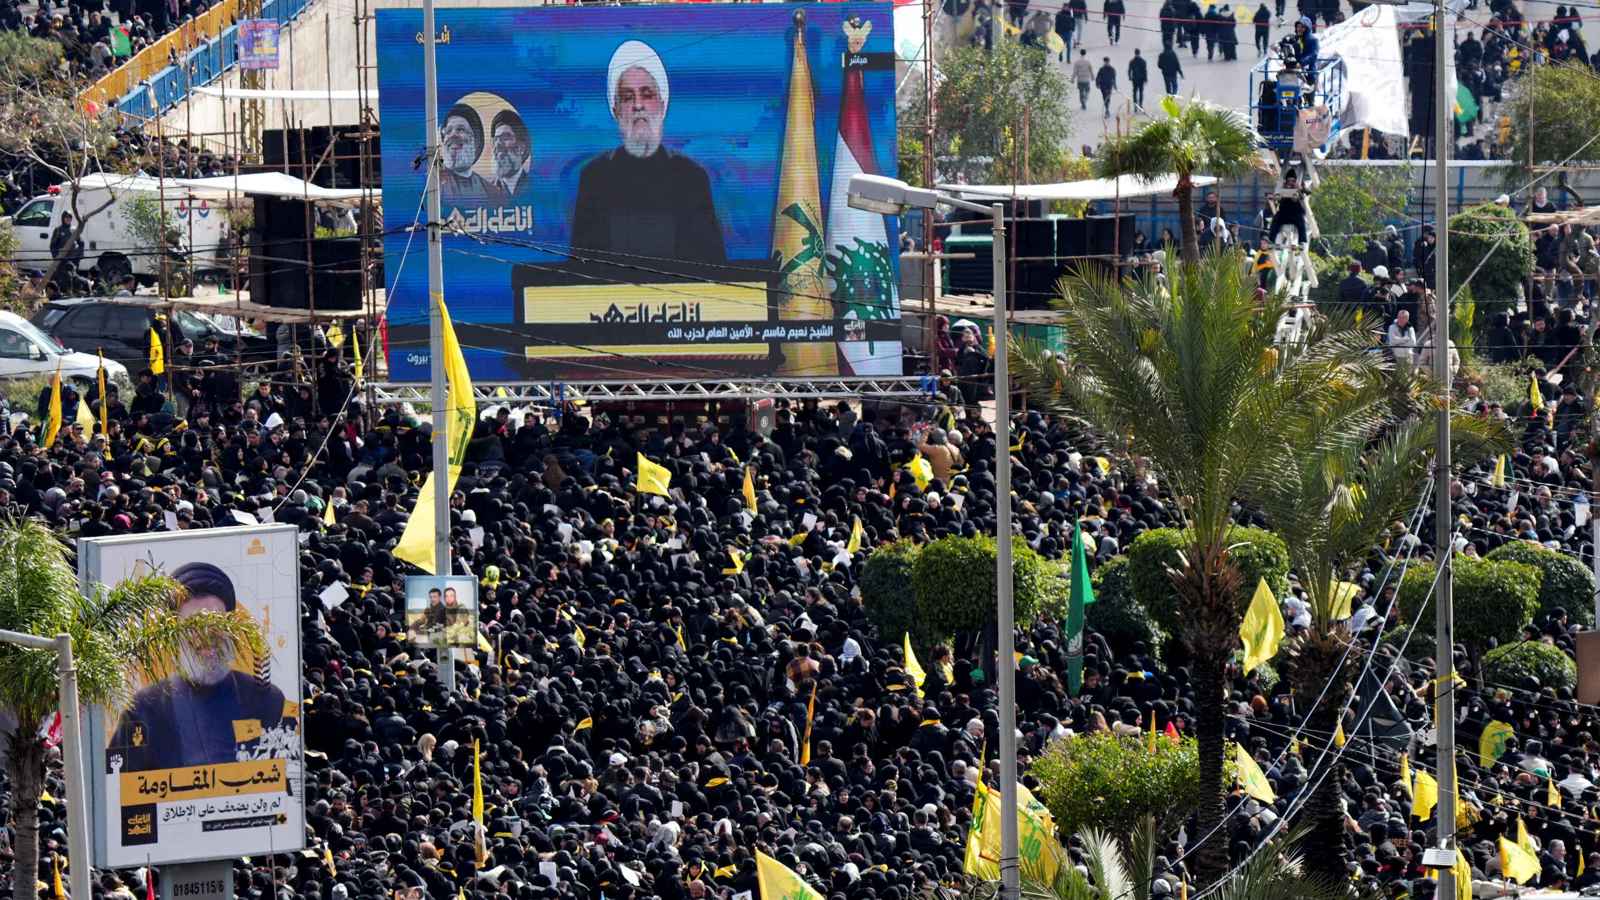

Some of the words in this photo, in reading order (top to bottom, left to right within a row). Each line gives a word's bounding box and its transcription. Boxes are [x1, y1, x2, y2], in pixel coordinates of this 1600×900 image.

[668, 327, 682, 338] الله
[684, 327, 705, 341] لحزب
[705, 327, 727, 341] العام
[729, 323, 753, 339] الأمين
[762, 326, 785, 340] قاسم
[787, 326, 808, 340] نعيم
[809, 325, 834, 340] الشيخ
[407, 352, 428, 366] بيروت
[138, 767, 215, 798] المقاومة
[218, 764, 281, 793] شعب
[198, 804, 215, 817] على
[217, 801, 249, 815] يضعف
[252, 798, 268, 813] ولن
[271, 797, 281, 811] لم
[163, 804, 196, 822] الإطلاق
